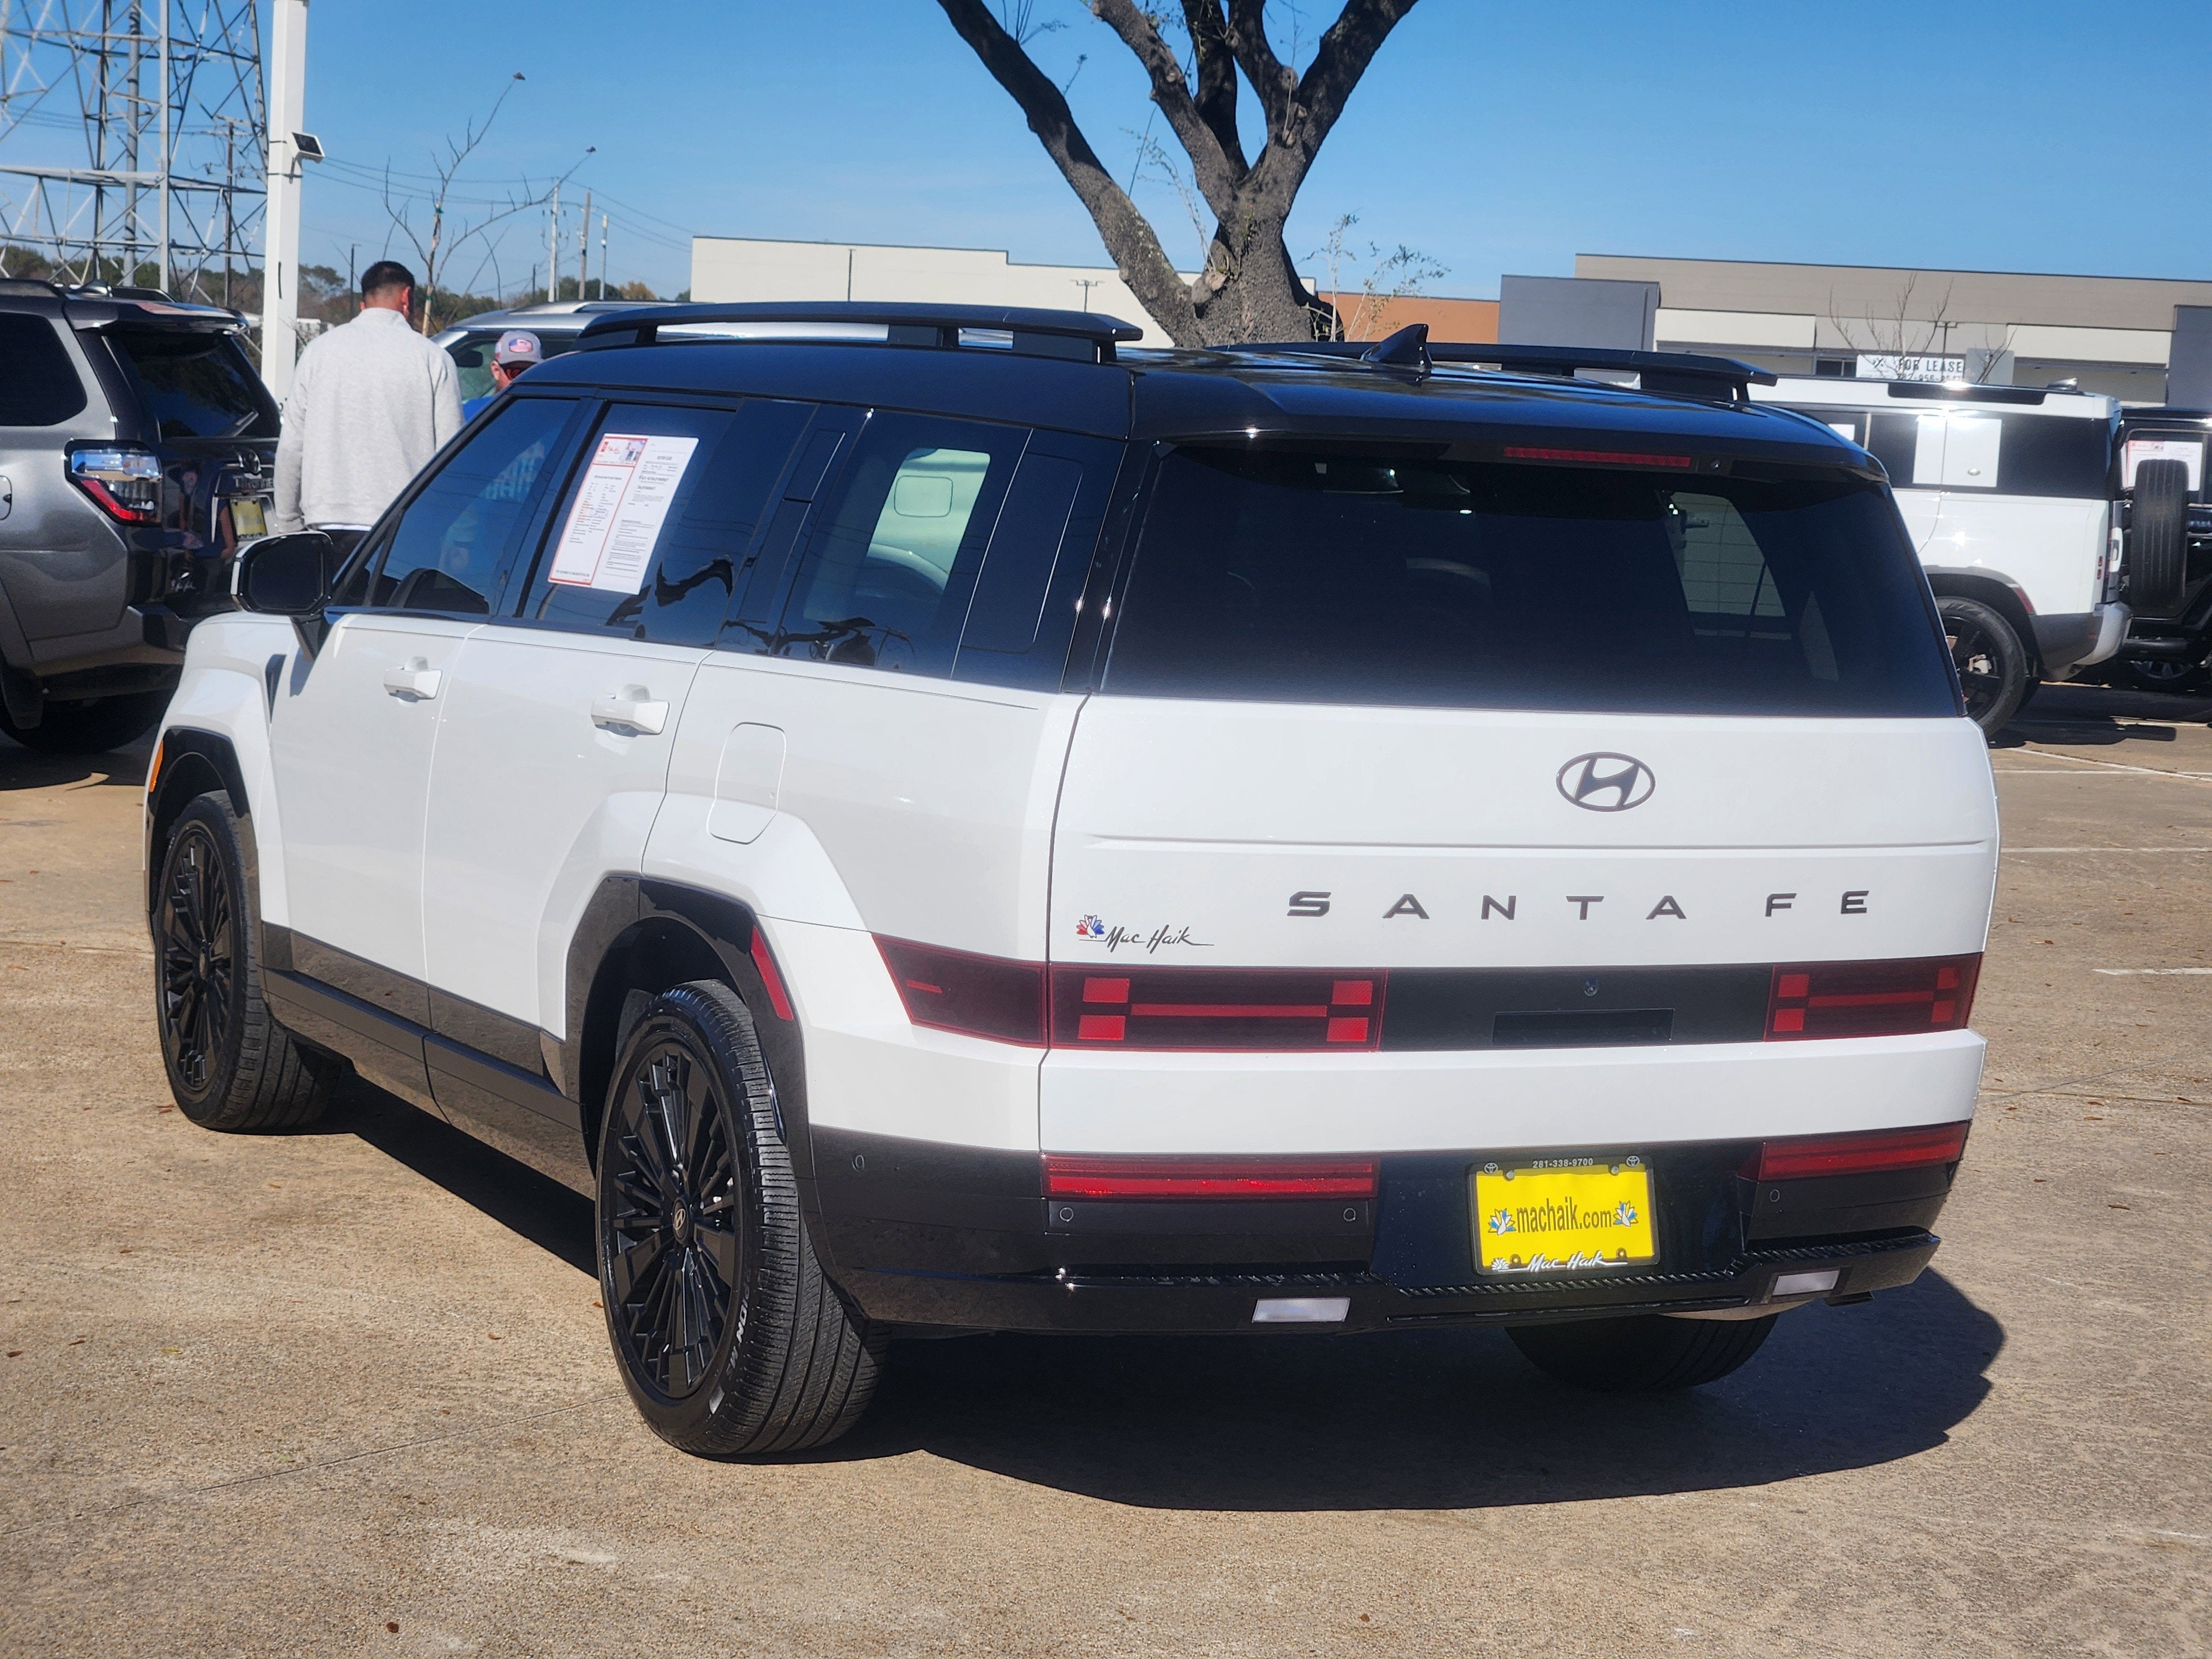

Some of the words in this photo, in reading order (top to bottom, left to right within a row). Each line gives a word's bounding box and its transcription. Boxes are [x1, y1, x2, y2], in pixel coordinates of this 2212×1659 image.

[1898, 358, 1919, 371] FOR
[1927, 360, 1962, 373] LEASE
[1287, 891, 1687, 921] SANTA
[1765, 890, 1870, 918] FE
[1105, 925, 1146, 953] Mac
[1146, 924, 1206, 954] Haik
[1532, 1157, 1594, 1168] 281-338-9700
[1516, 1196, 1612, 1233] machaik.com
[1527, 1252, 1566, 1272] Mac
[1566, 1250, 1616, 1271] Haik
